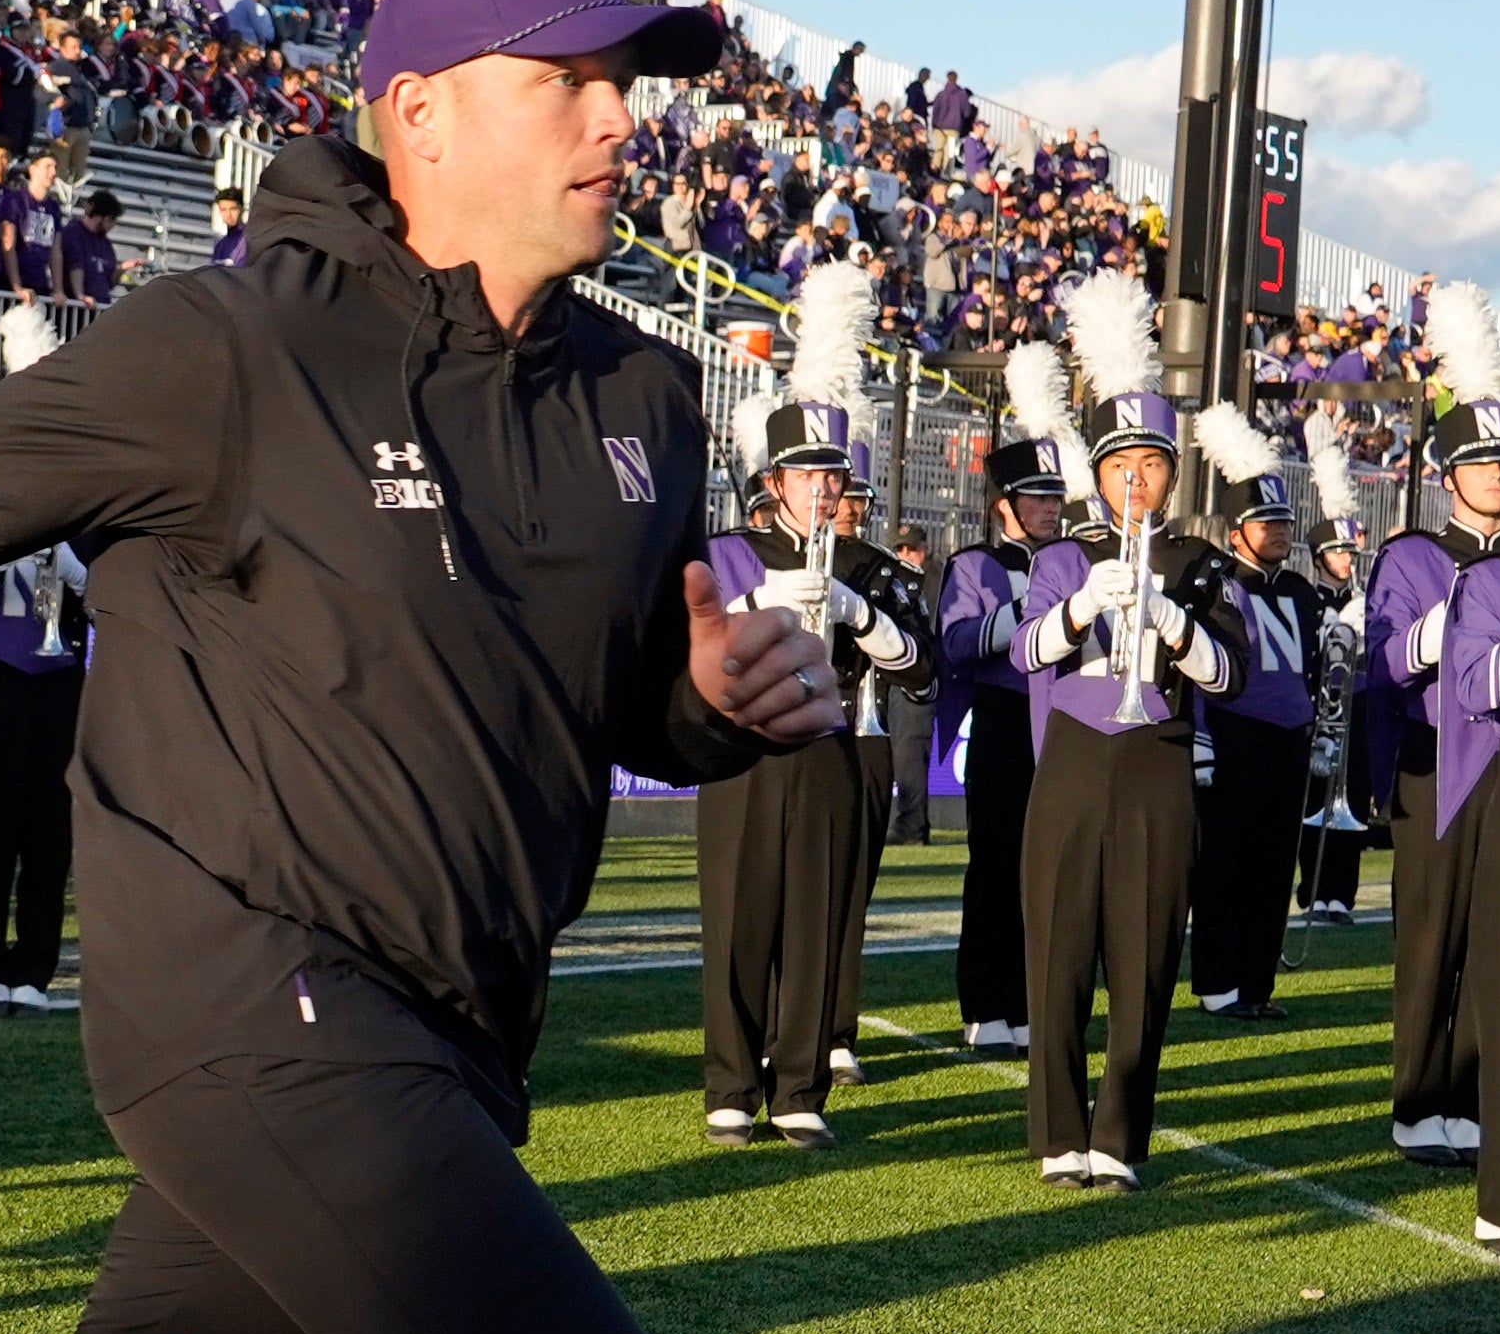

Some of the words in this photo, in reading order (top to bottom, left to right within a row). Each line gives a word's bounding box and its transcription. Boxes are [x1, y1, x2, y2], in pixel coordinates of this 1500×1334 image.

[804, 408, 830, 443] N
[1116, 398, 1142, 429] N
[602, 436, 656, 503] N
[1036, 444, 1058, 474] N
[1258, 479, 1282, 504] N
[1249, 594, 1303, 673] N
